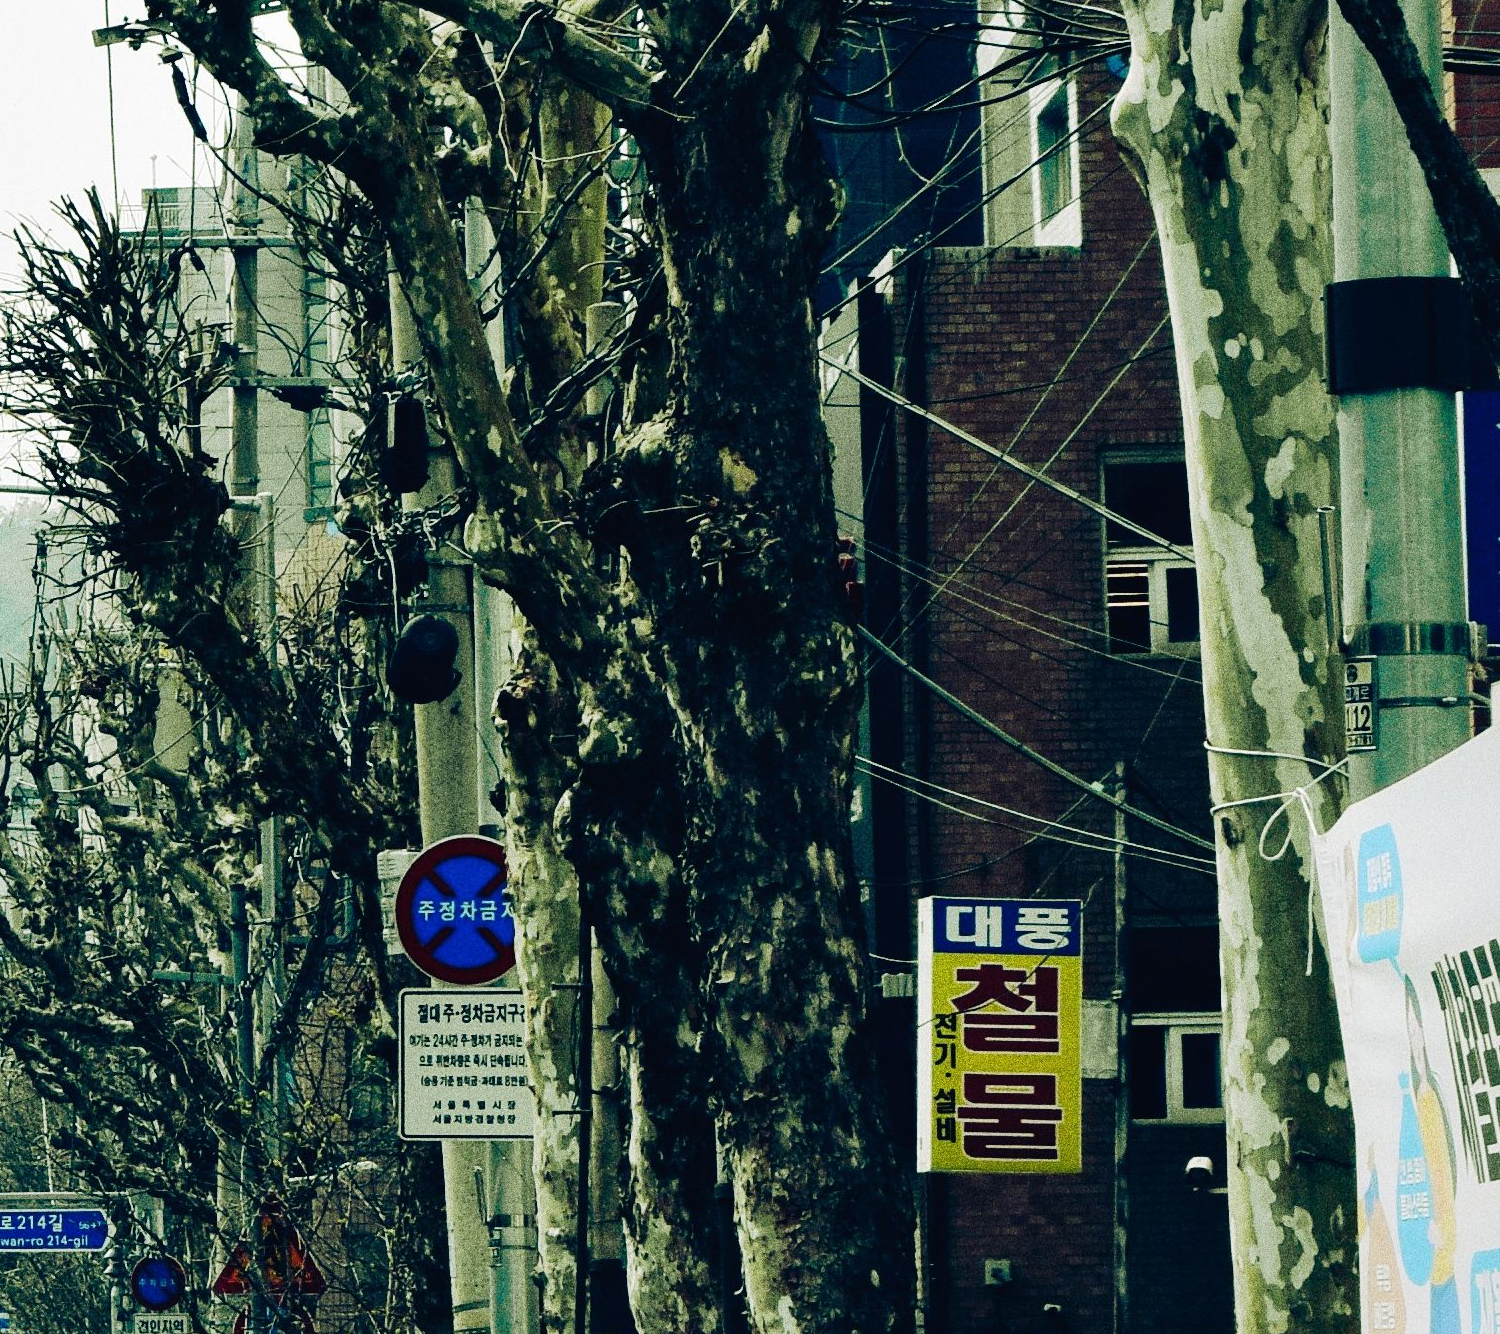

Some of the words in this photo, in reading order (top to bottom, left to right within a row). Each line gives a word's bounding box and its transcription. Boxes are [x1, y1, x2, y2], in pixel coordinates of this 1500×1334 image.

[946, 906, 1071, 950] 대풍
[418, 1003, 440, 1023] 절대
[951, 964, 1062, 1159] 철물
[933, 1013, 957, 1143] 전기·설비
[47, 1235, 89, 1249] 214-gil
[137, 1318, 184, 1334] 견인지역
